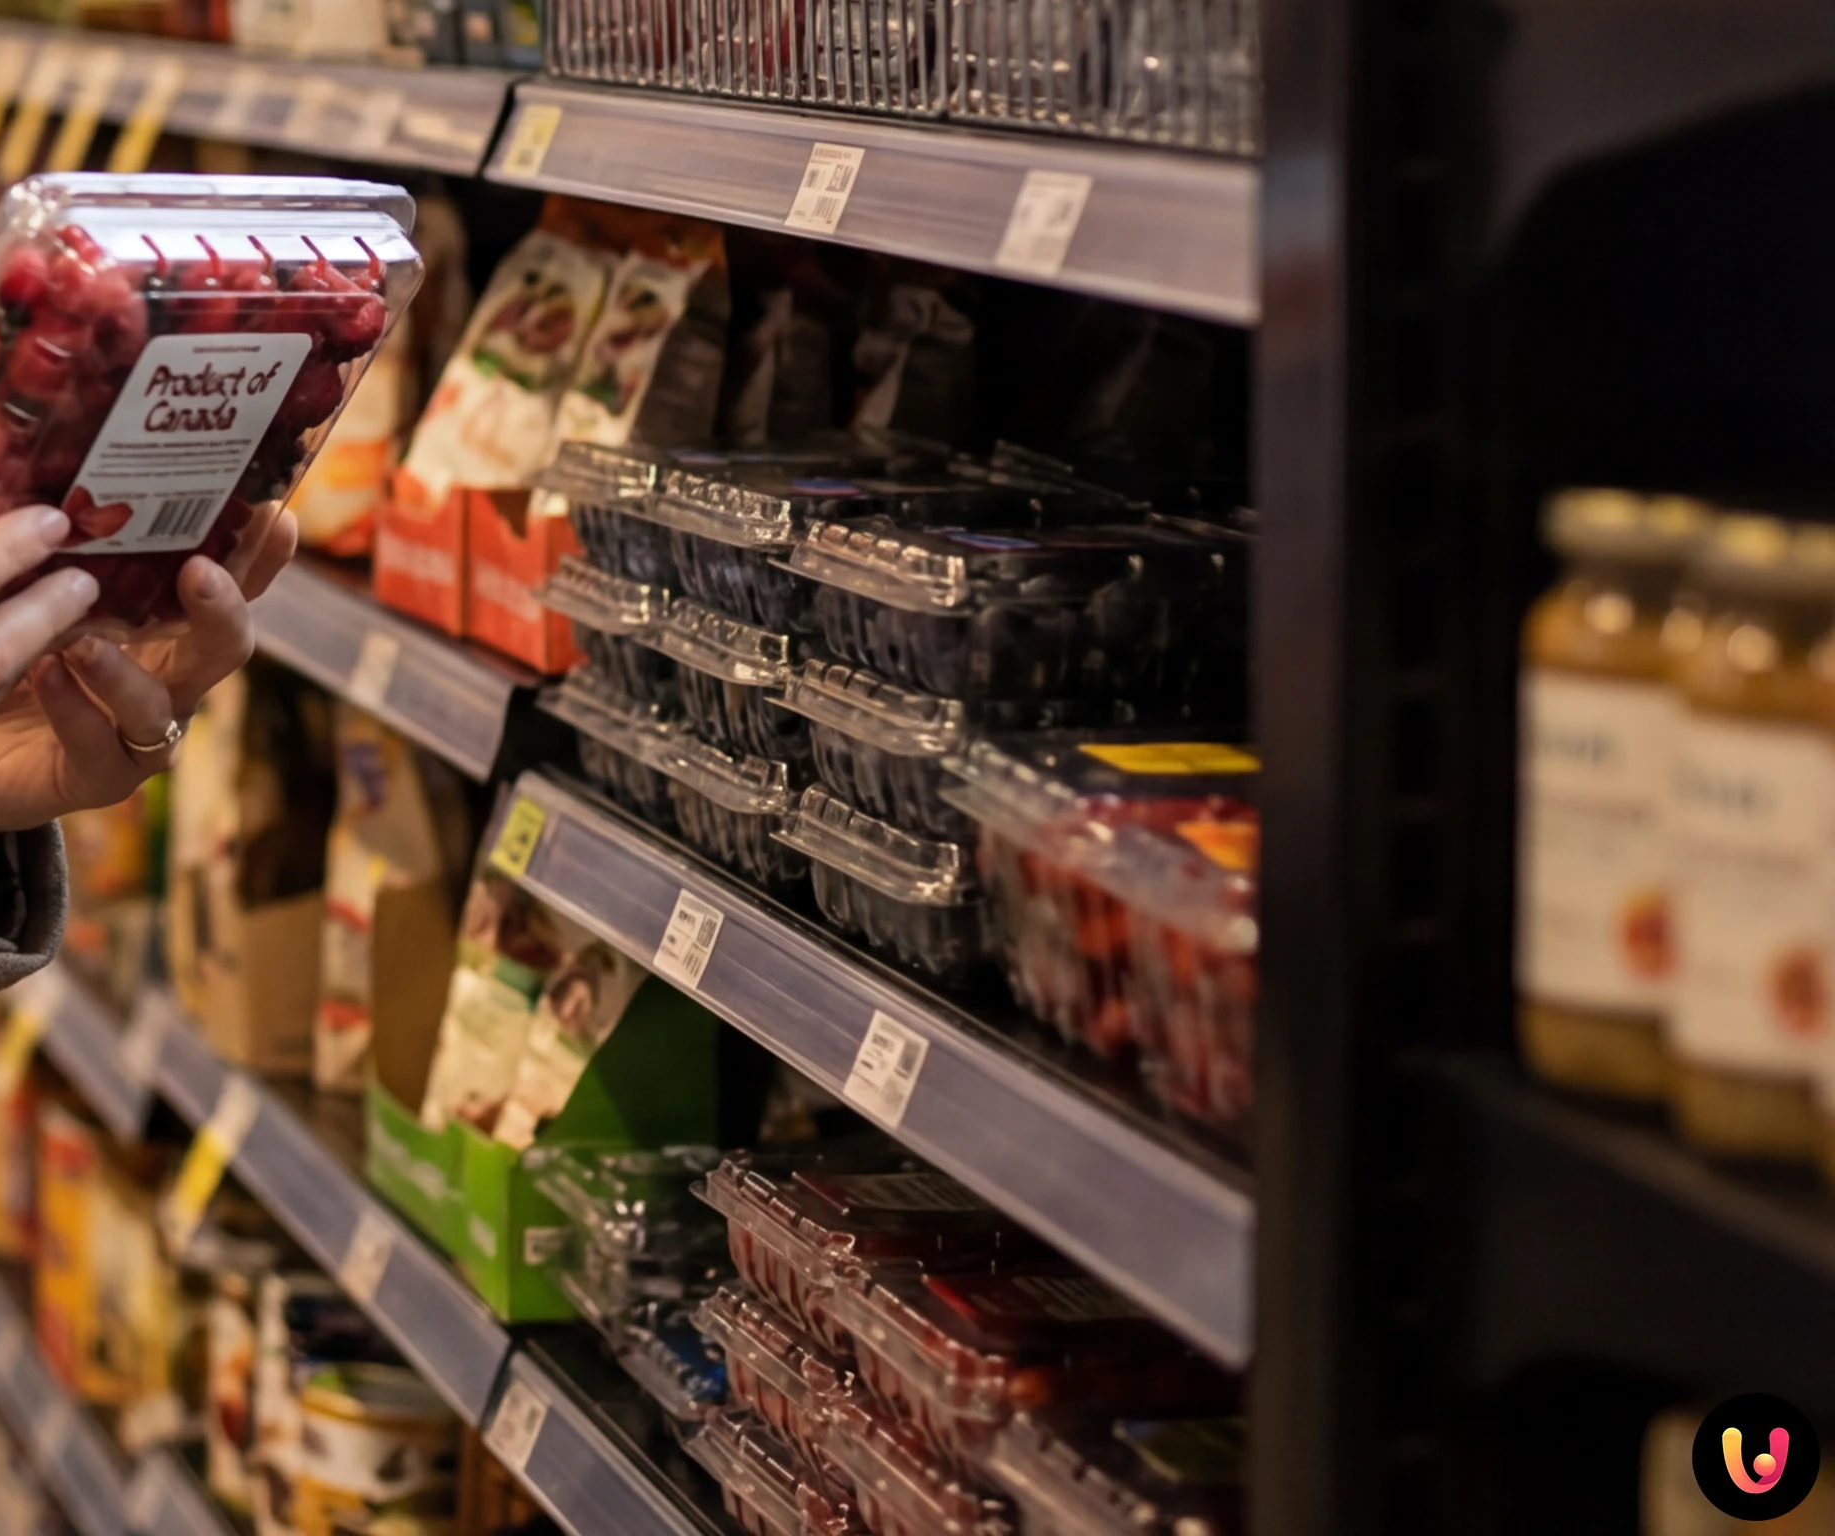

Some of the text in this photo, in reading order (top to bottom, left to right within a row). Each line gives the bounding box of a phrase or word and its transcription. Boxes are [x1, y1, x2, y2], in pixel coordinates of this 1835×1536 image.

[145, 361, 282, 398] Product of
[144, 398, 237, 432] Canada
